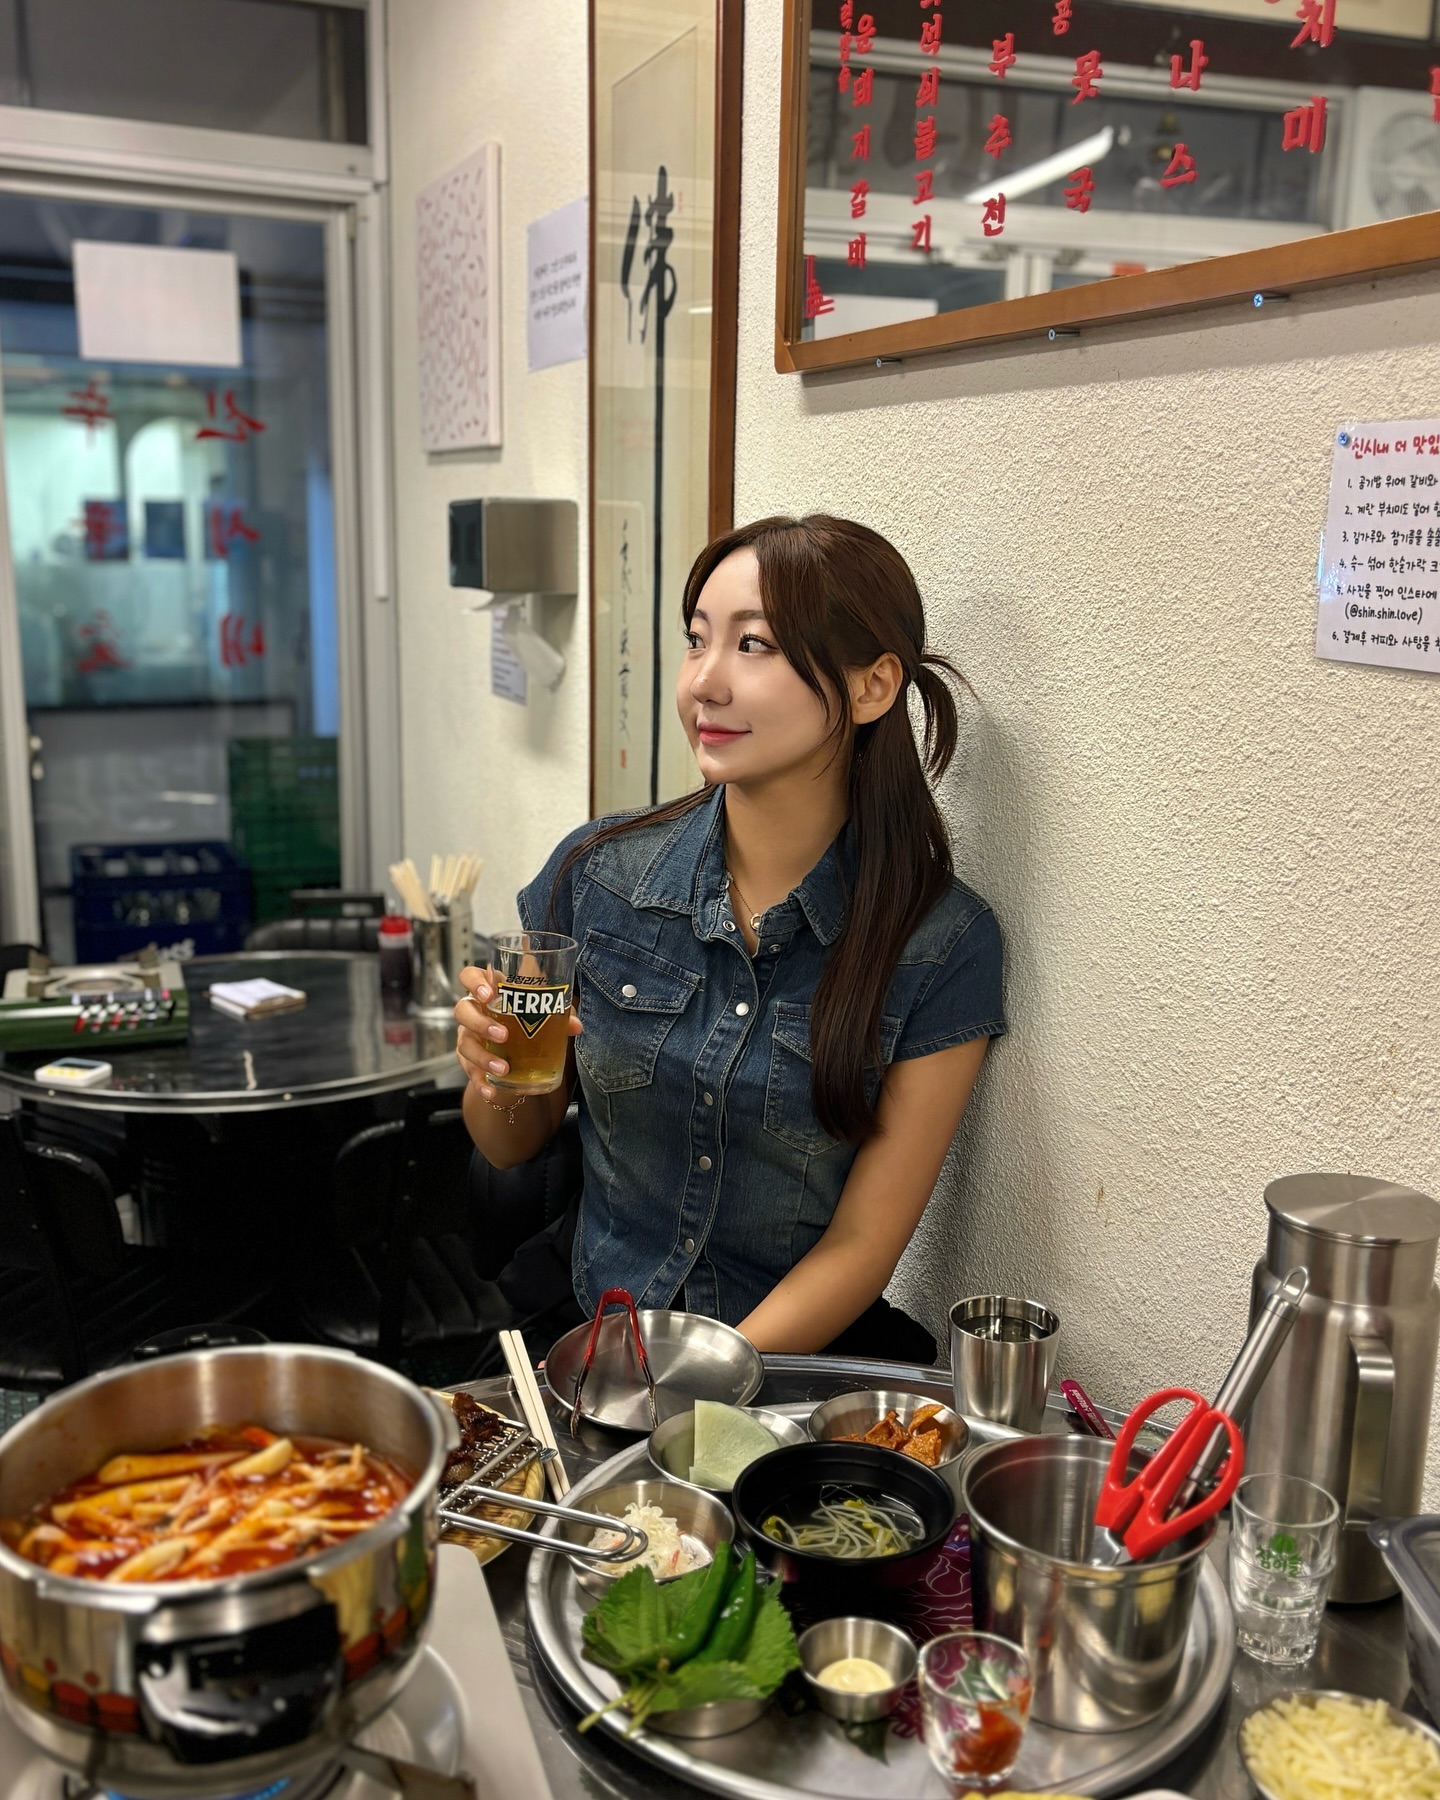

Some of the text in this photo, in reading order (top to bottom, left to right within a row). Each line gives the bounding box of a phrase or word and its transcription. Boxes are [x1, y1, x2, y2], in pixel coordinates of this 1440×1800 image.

[1394, 440, 1407, 452] 더
[1347, 474, 1438, 490] 1. 공기밥 위에 갈비와
[1344, 506, 1353, 516] 2.
[1412, 502, 1430, 517] 넣어
[1342, 531, 1349, 543] 3.
[1353, 530, 1386, 545] 김가루와
[1390, 528, 1423, 546] 참기름을
[1338, 558, 1346, 569] 4.
[1368, 556, 1386, 572] 섞어
[1430, 560, 1440, 572] 크
[1336, 584, 1438, 600] 5. 사진을 찍어 인스타에
[1344, 602, 1423, 625] (@shin.shin.love)
[1332, 631, 1340, 642] 6.
[1370, 633, 1398, 646] 커피와
[1402, 635, 1430, 652] 사탕을
[498, 988, 566, 1014] TERRA
